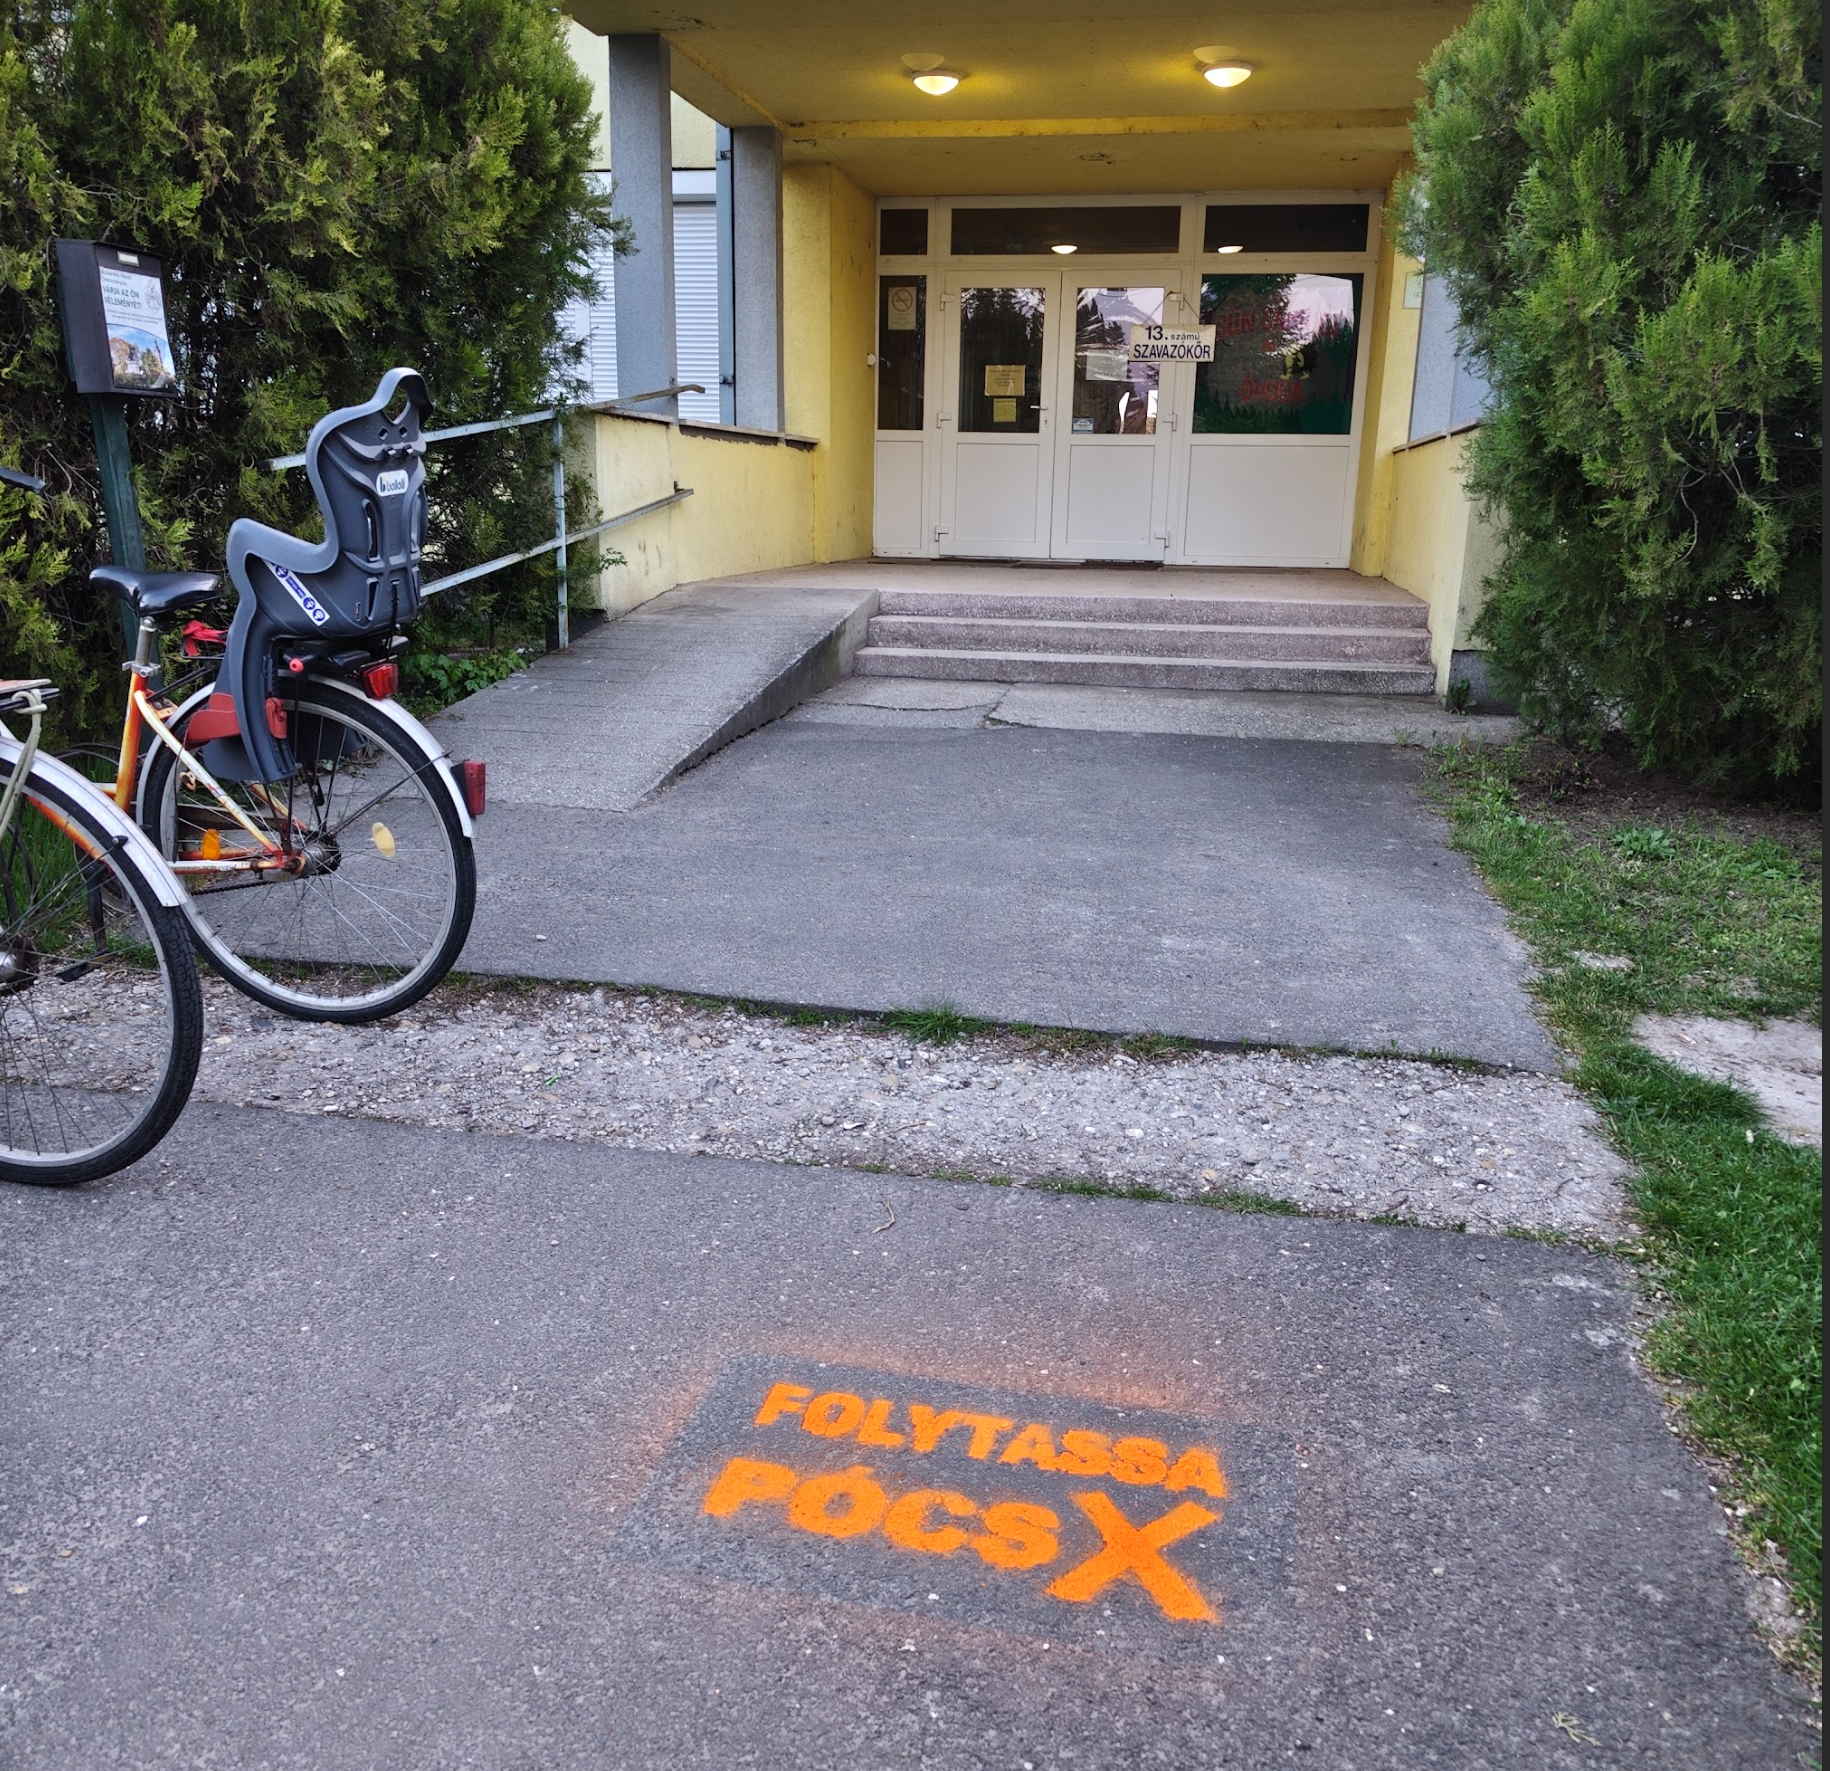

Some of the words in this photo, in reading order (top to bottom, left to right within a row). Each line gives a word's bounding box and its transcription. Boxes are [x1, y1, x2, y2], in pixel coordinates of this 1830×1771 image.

[103, 285, 120, 296] VÁRJA
[121, 288, 129, 297] AZ
[130, 288, 140, 299] ÖN
[1145, 325, 1168, 341] 13.
[1133, 341, 1211, 360] SZAVAZÓKÖR
[1241, 371, 1305, 403] ÓVODA
[754, 1381, 1229, 1499] FOLYTASSA
[703, 1455, 1061, 1570] PÓCS
[1044, 1490, 1222, 1623] X
